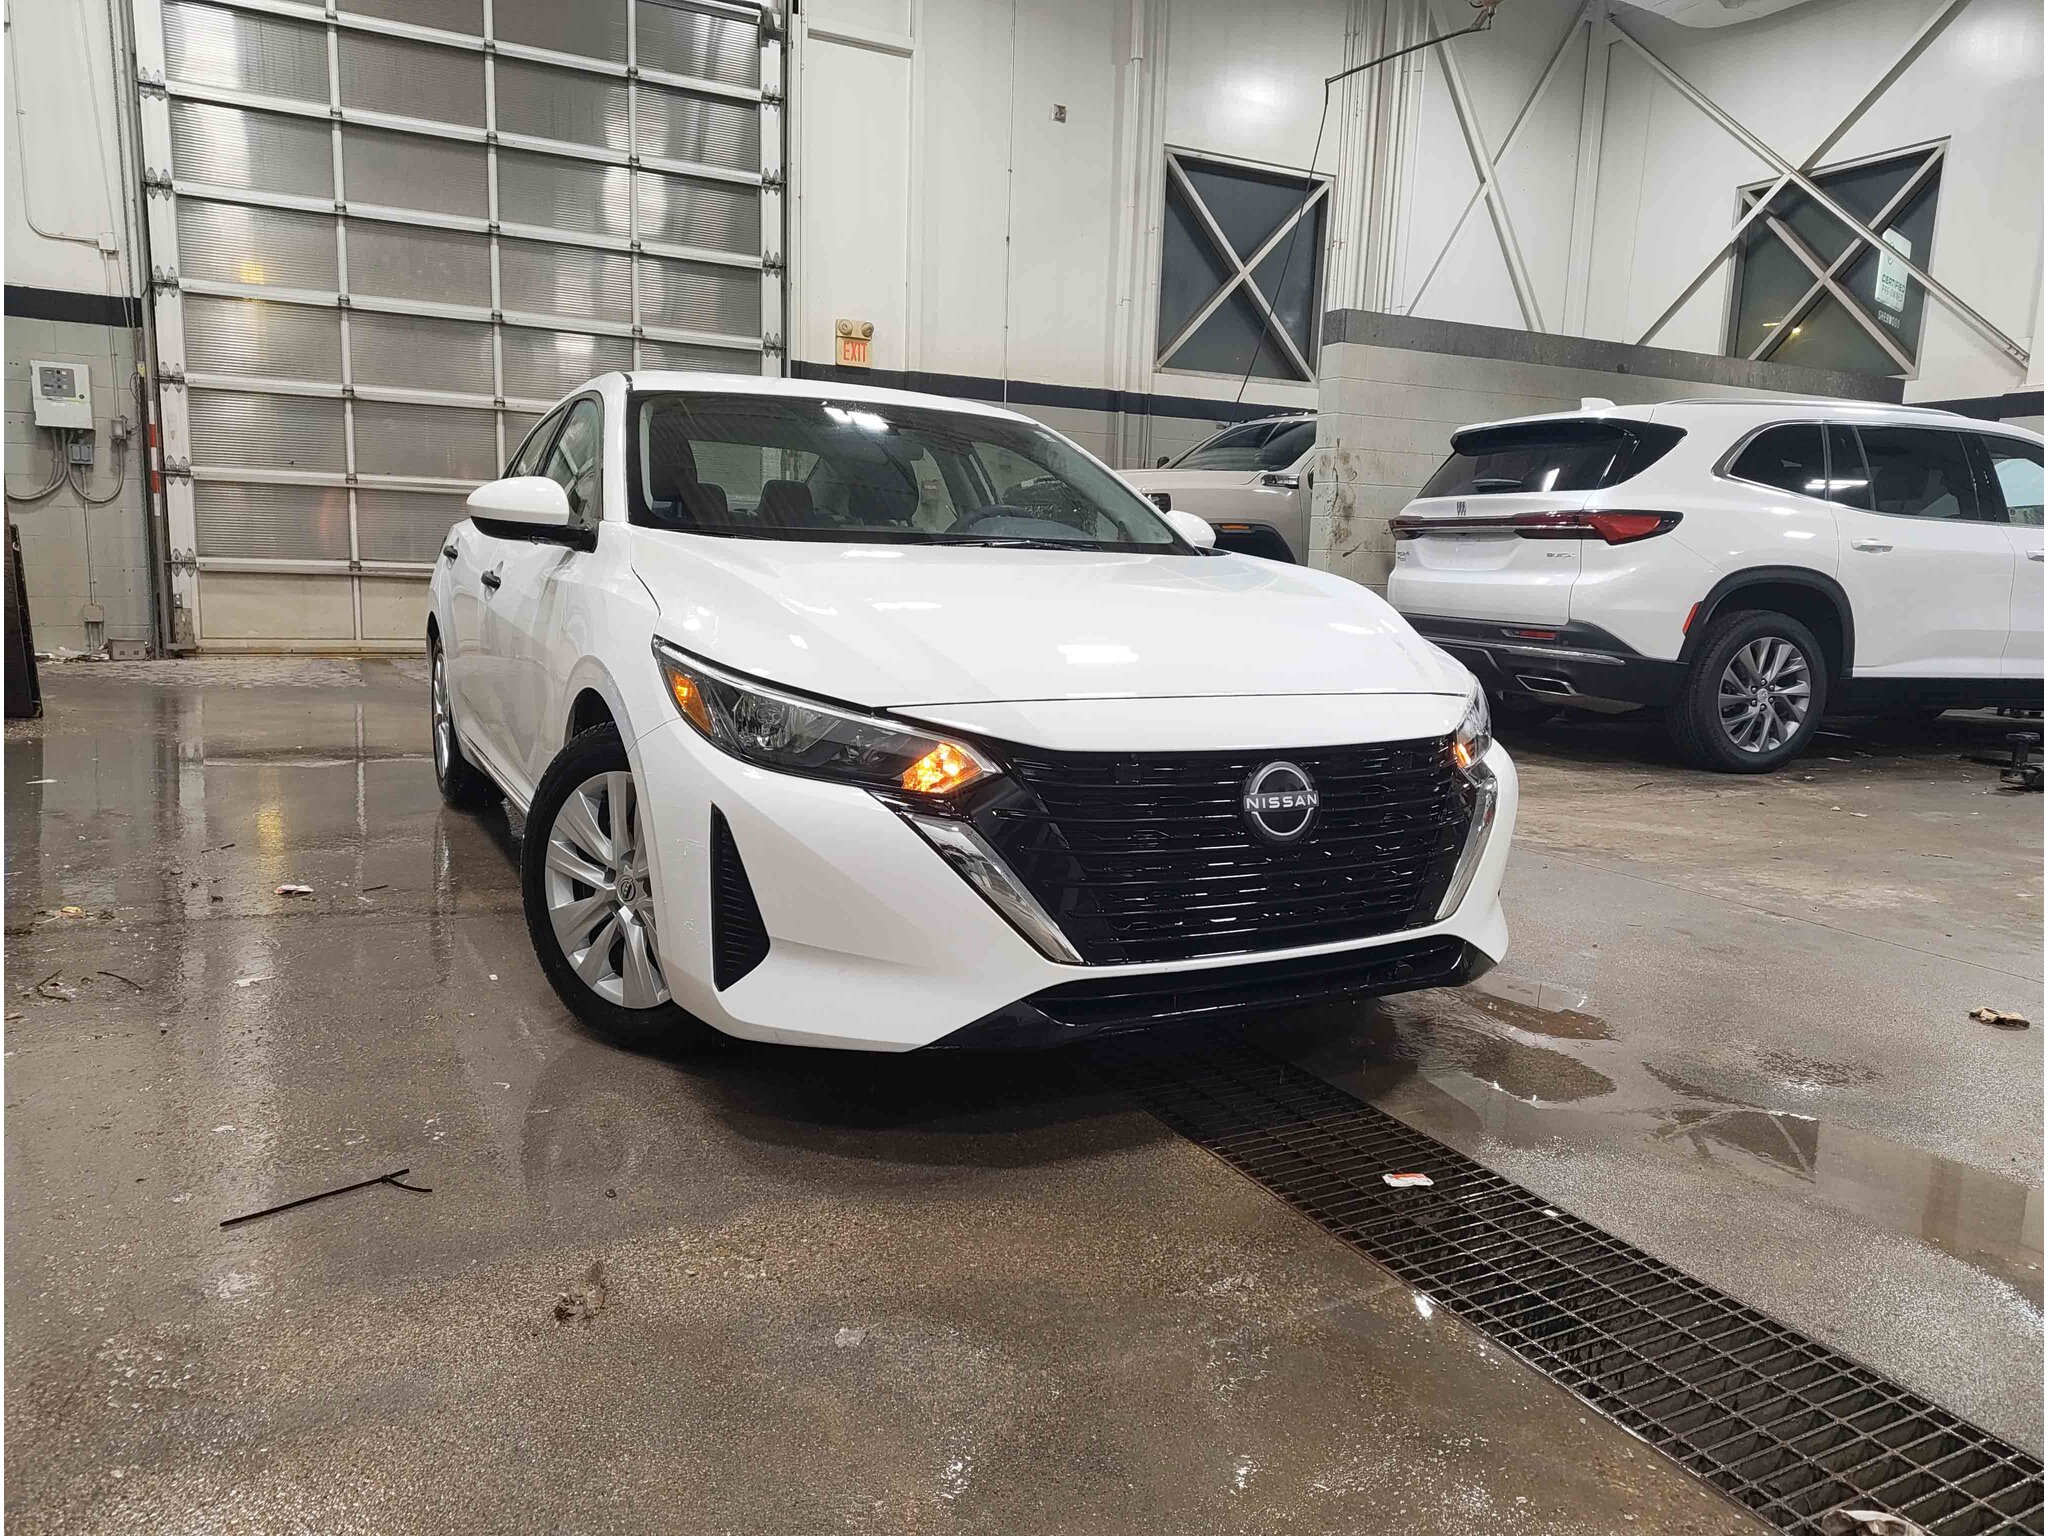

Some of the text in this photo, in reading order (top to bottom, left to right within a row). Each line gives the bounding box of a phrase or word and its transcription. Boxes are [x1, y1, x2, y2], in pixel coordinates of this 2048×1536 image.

[1881, 273, 1906, 294] CERTIFIED
[843, 340, 868, 362] EXIT
[1246, 794, 1317, 809] NISSAN
